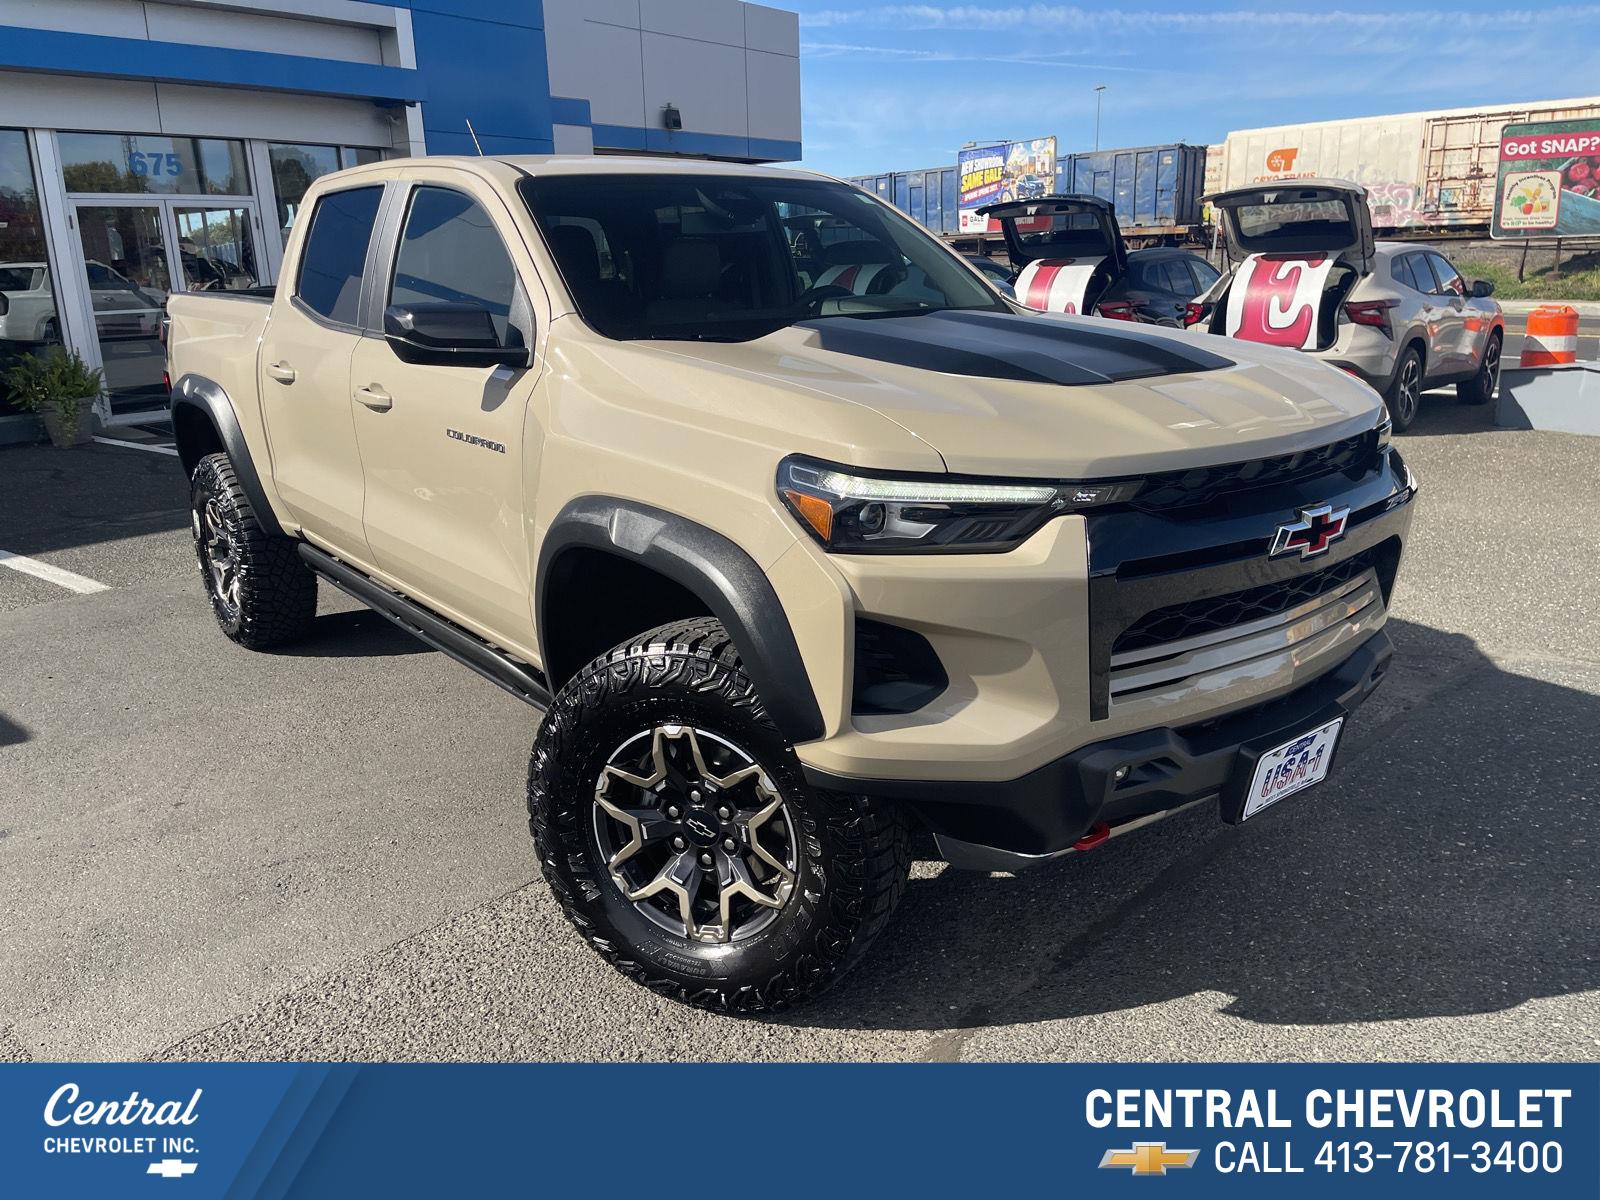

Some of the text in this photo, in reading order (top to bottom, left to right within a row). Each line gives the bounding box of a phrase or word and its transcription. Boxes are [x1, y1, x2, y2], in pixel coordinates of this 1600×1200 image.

[1504, 136, 1600, 156] Got SNAP?
[128, 151, 183, 177] 675
[961, 167, 1003, 193] SAME GALE
[446, 428, 506, 454] COLORADO
[1288, 739, 1313, 754] CENTRAL
[1261, 743, 1325, 798] USA-1
